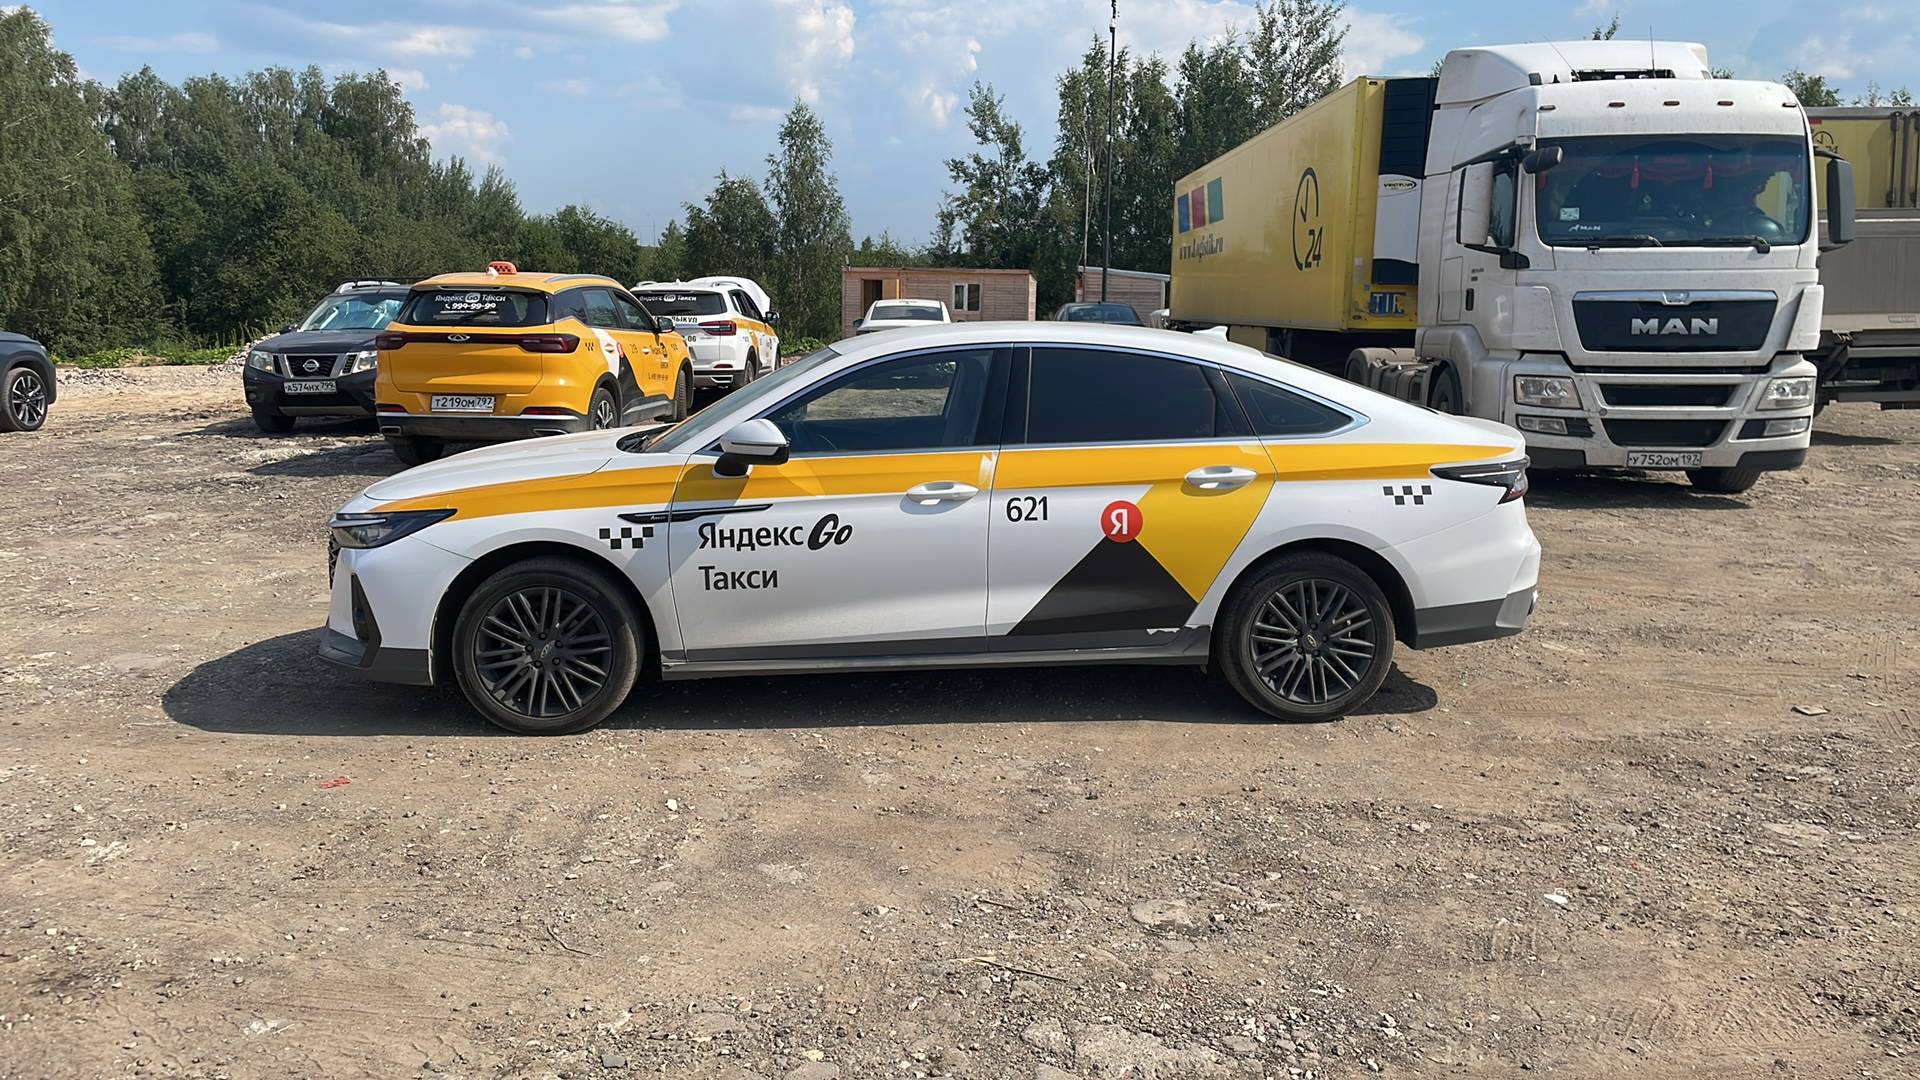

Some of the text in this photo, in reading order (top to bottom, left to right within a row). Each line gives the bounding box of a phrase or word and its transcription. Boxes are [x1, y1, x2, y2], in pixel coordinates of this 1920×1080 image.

[1304, 226, 1324, 268] 24
[1631, 318, 1718, 335] MAN
[1006, 495, 1049, 523] 621
[1110, 508, 1128, 535] Я
[698, 513, 853, 551] Яндекс Go
[698, 565, 779, 591] Такси
